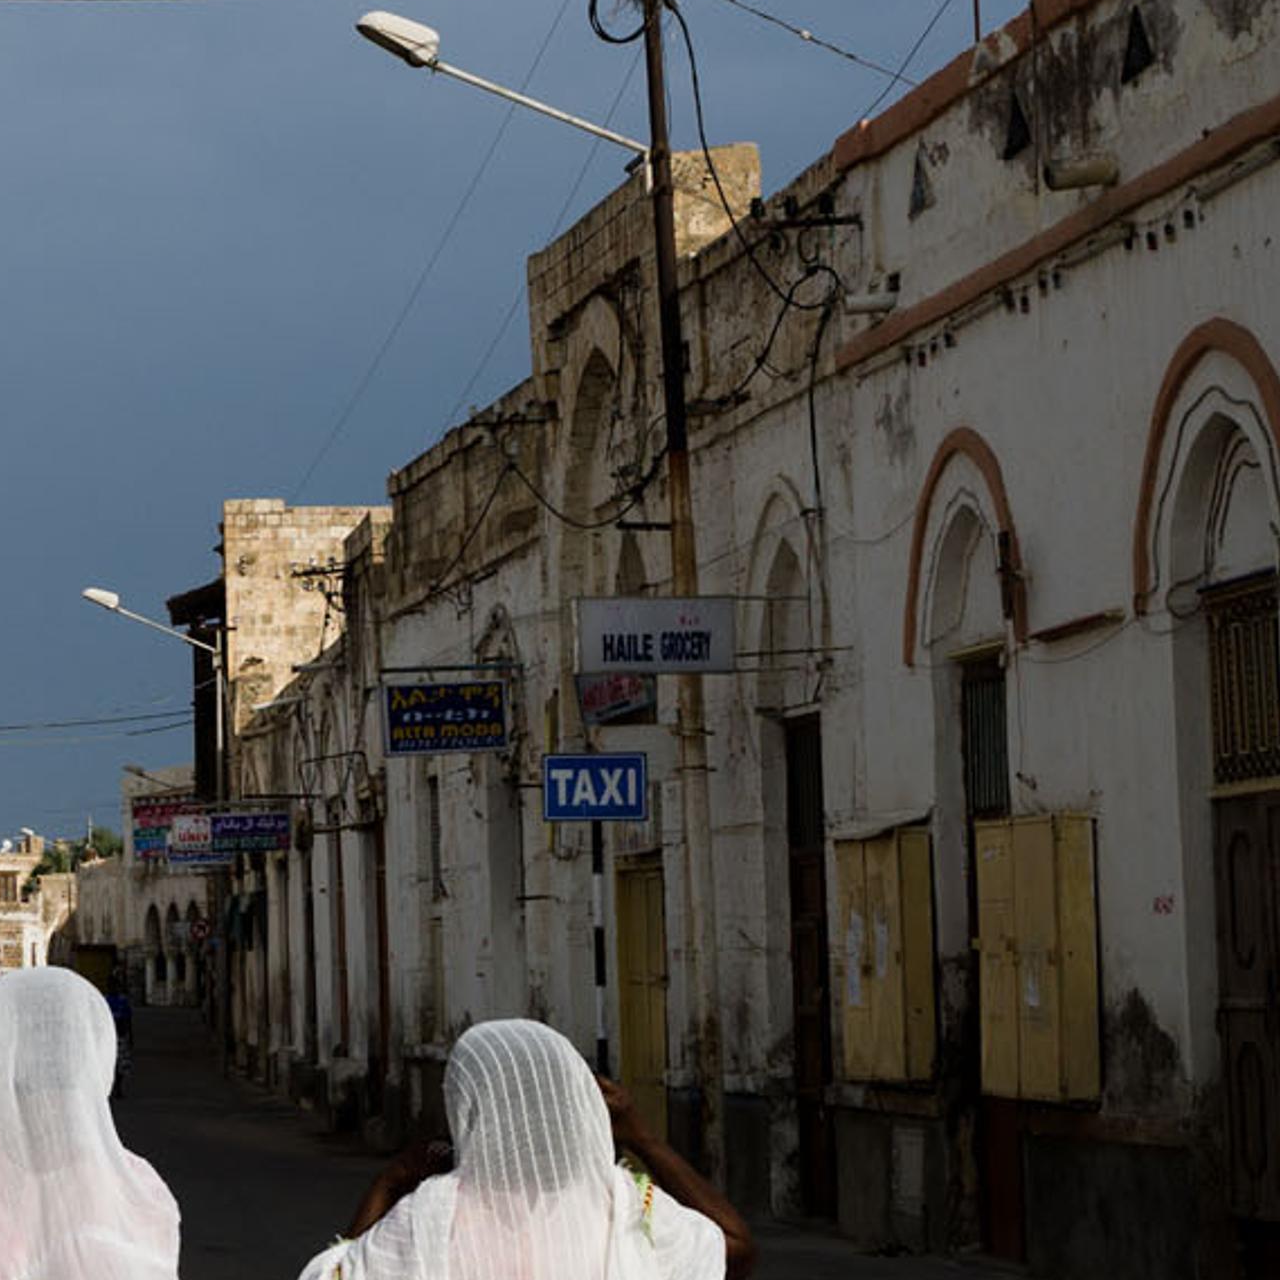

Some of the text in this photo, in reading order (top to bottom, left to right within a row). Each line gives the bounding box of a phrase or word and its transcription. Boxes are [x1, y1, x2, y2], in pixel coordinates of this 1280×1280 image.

[603, 630, 712, 663] HAILE GROCERY
[550, 767, 637, 807] TAXI
